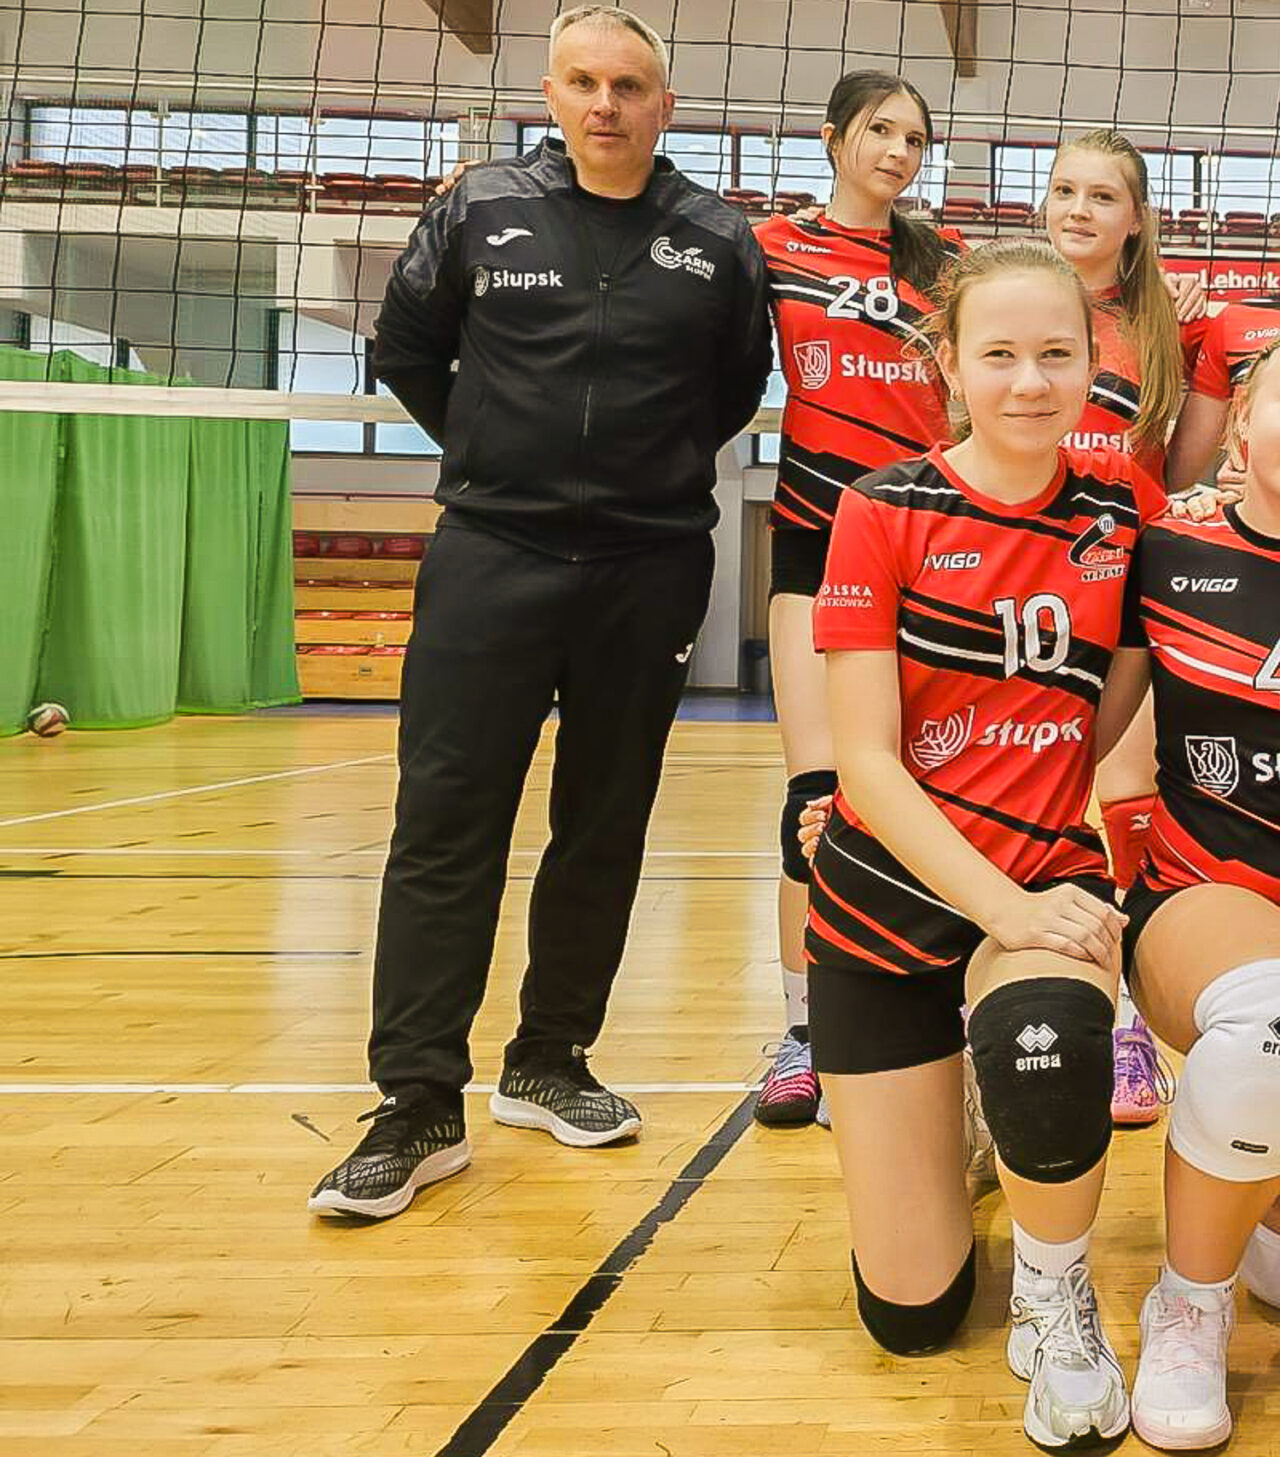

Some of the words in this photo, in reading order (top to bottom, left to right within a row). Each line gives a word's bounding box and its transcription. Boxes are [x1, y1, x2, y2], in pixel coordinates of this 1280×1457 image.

[492, 270, 564, 290] Słupsk
[826, 275, 899, 321] 28
[841, 353, 929, 384] Słupsk
[823, 584, 873, 597] OLSKA
[994, 593, 1071, 680] 10
[975, 716, 1085, 754] Słupk
